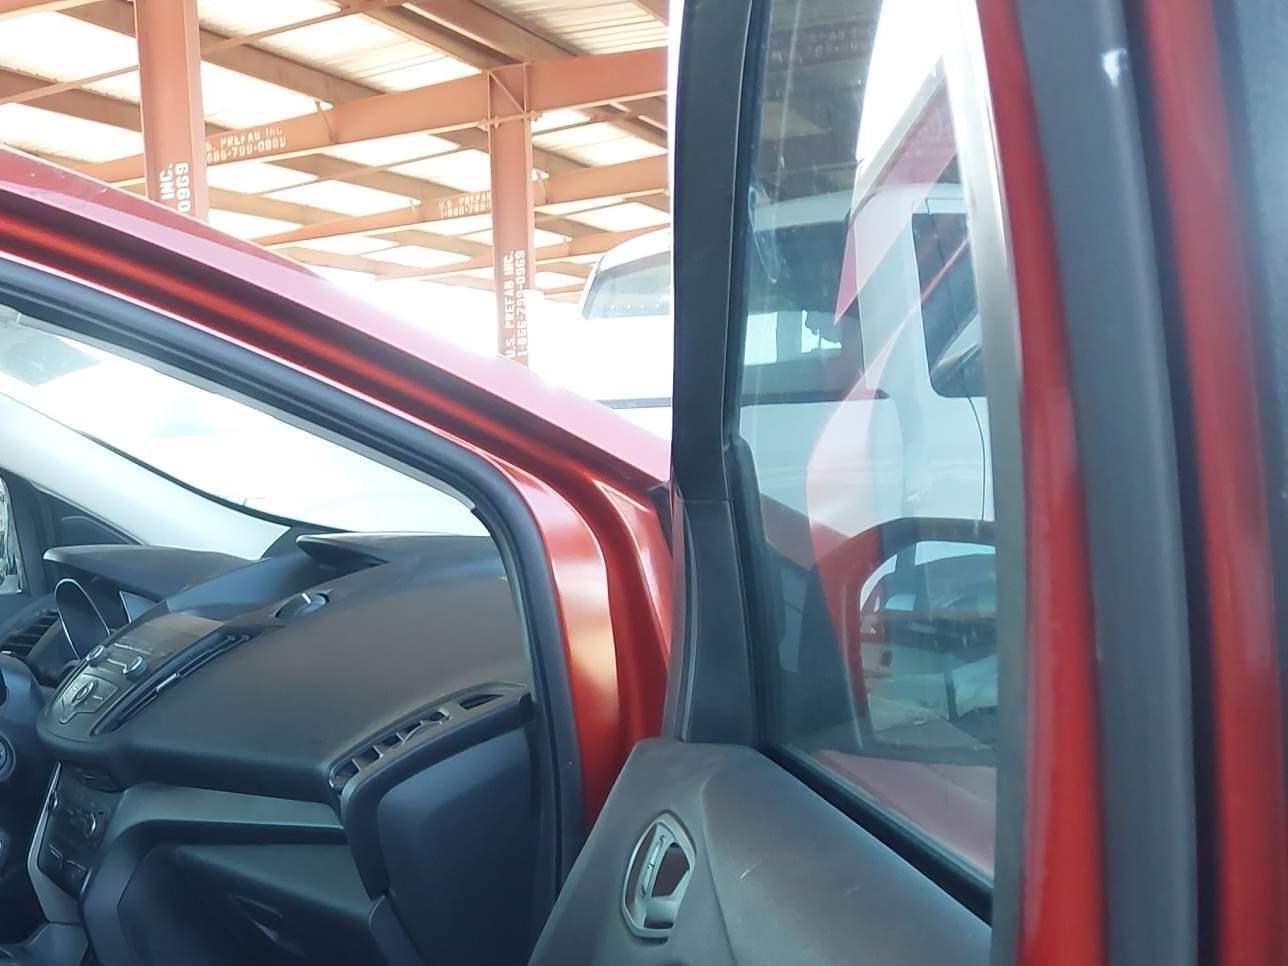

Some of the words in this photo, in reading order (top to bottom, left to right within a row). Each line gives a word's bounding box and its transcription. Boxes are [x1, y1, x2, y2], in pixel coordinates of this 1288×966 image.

[159, 163, 175, 200] INC.
[503, 250, 515, 276] INC.
[504, 280, 515, 329] PREFAB
